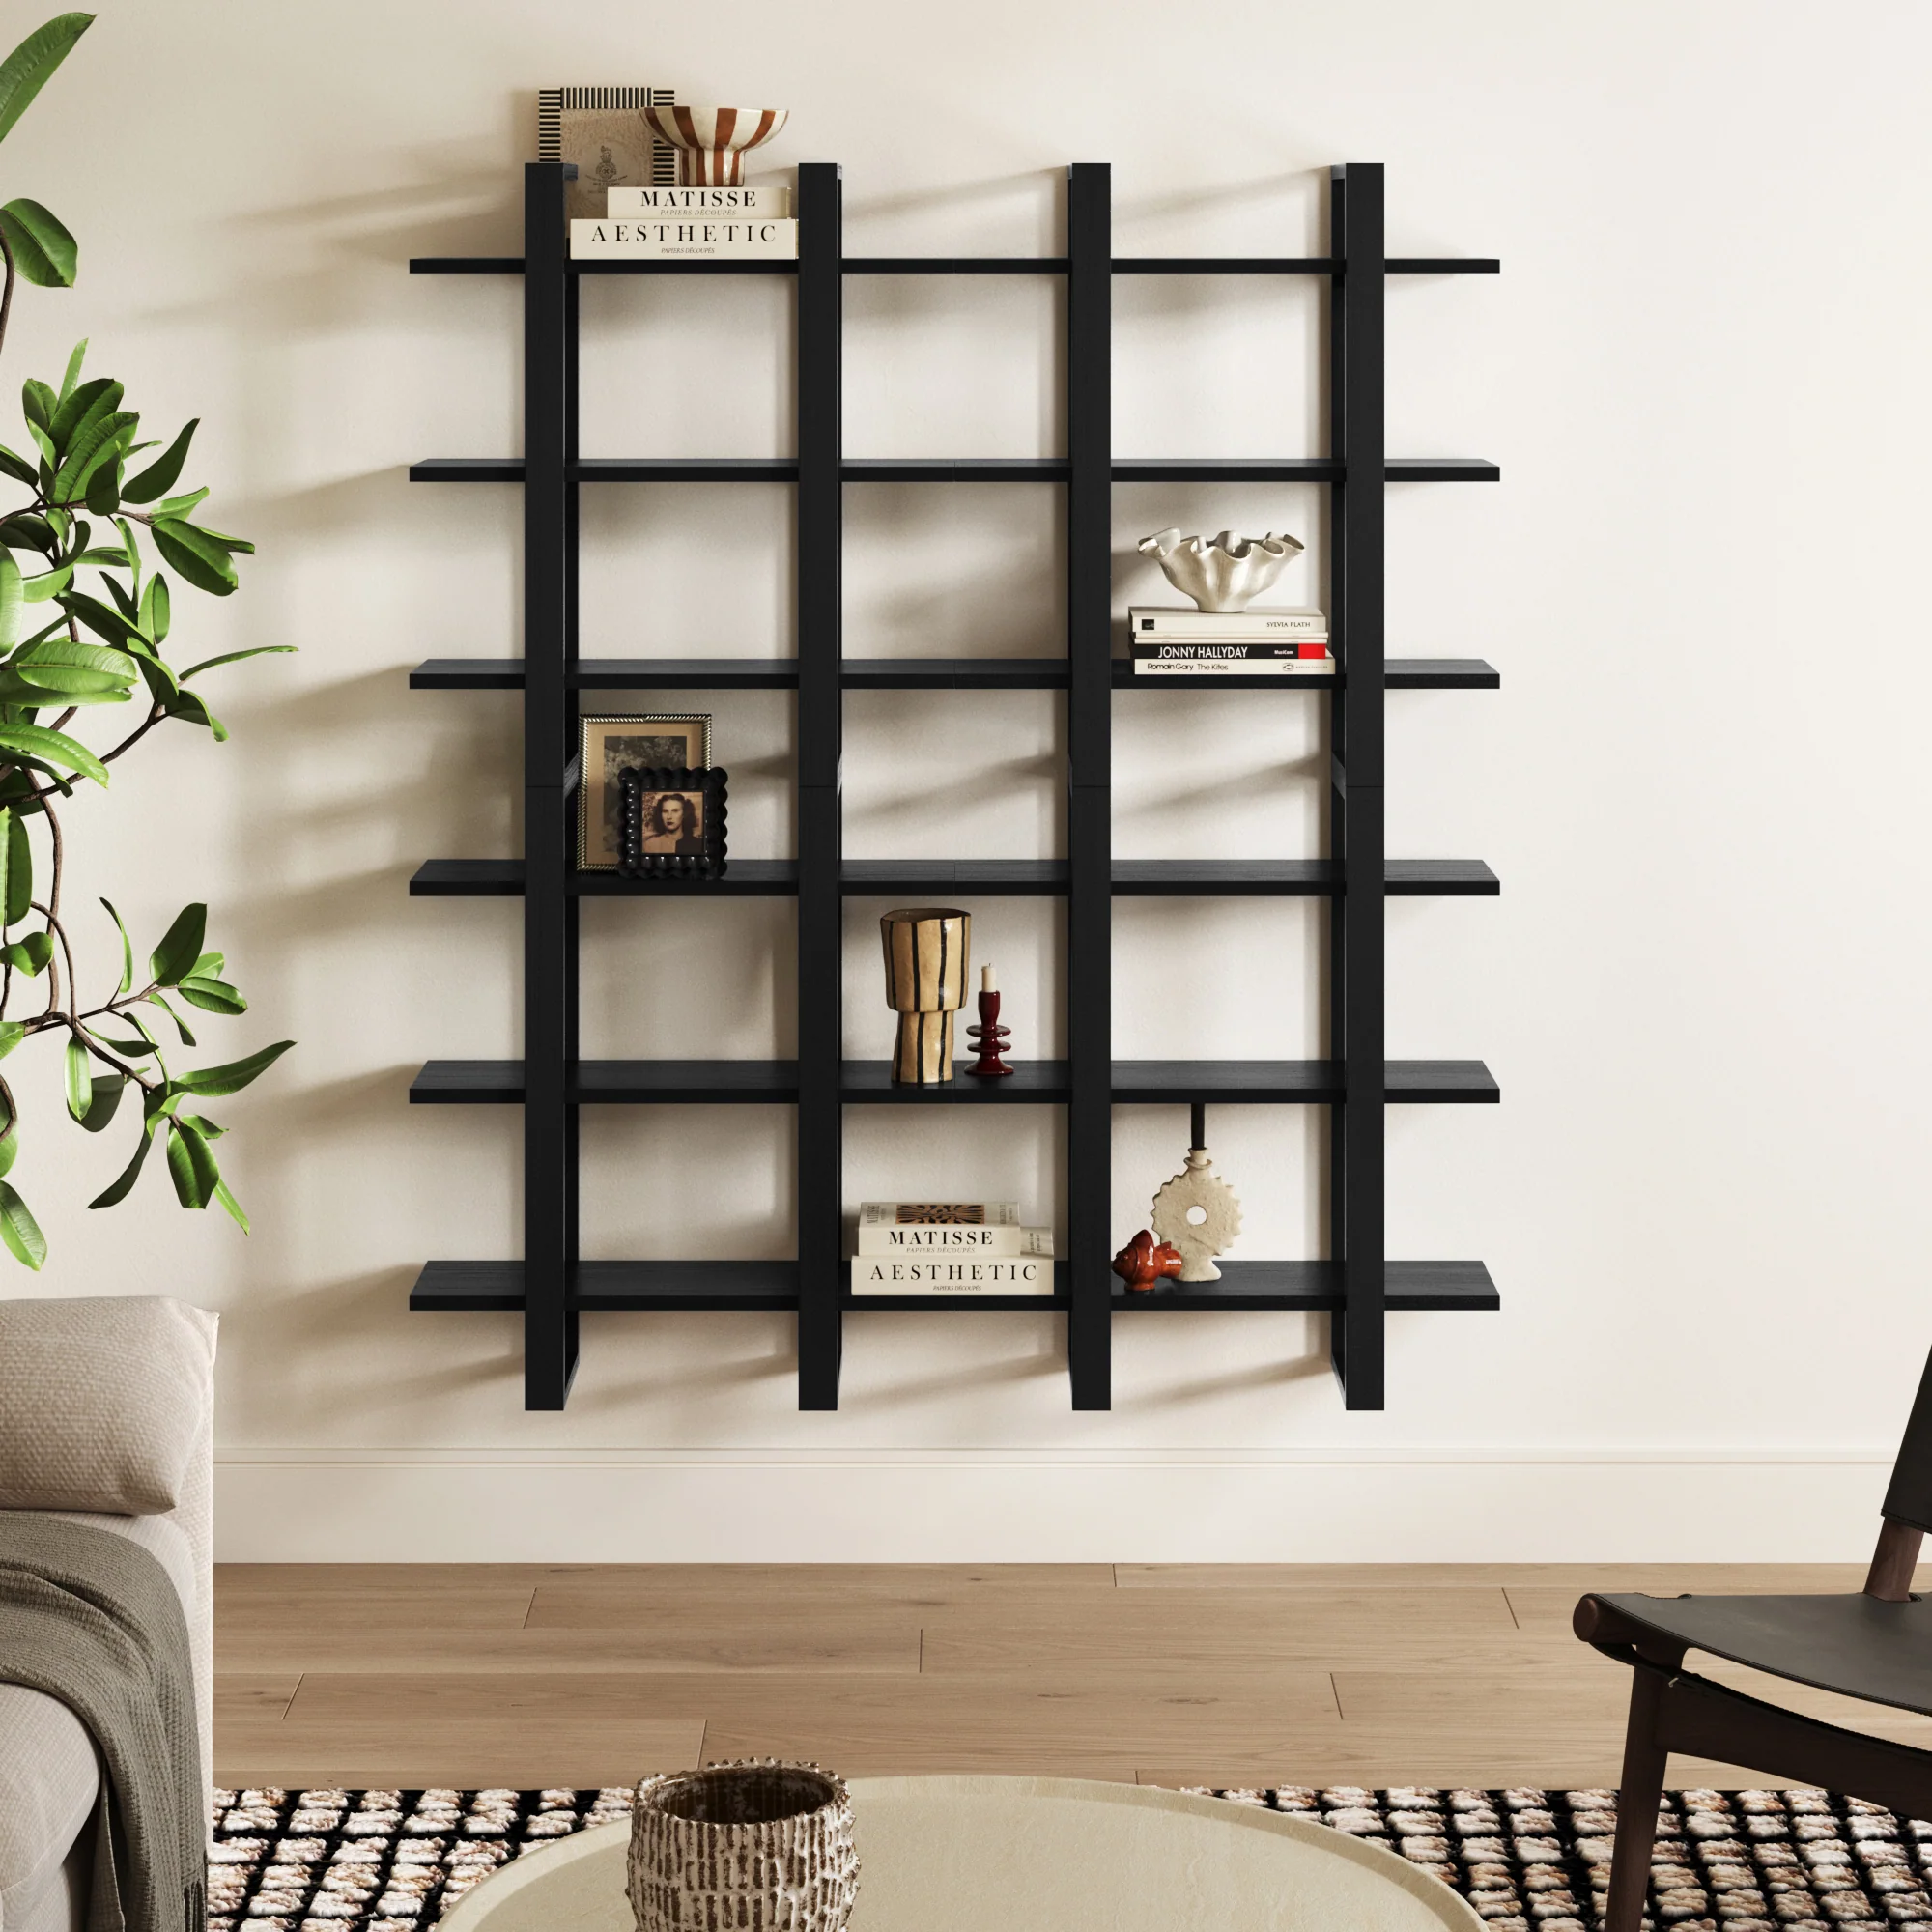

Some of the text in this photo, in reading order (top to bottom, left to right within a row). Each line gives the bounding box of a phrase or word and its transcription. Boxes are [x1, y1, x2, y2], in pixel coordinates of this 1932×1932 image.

[640, 191, 756, 207] MATISSE
[591, 225, 776, 242] AESTHETIC
[1157, 646, 1248, 659] JONNY HALLYDAY
[1176, 663, 1194, 671] Gary
[889, 1231, 993, 1245] MATISSE
[870, 1264, 1037, 1281] AESTHETIC
